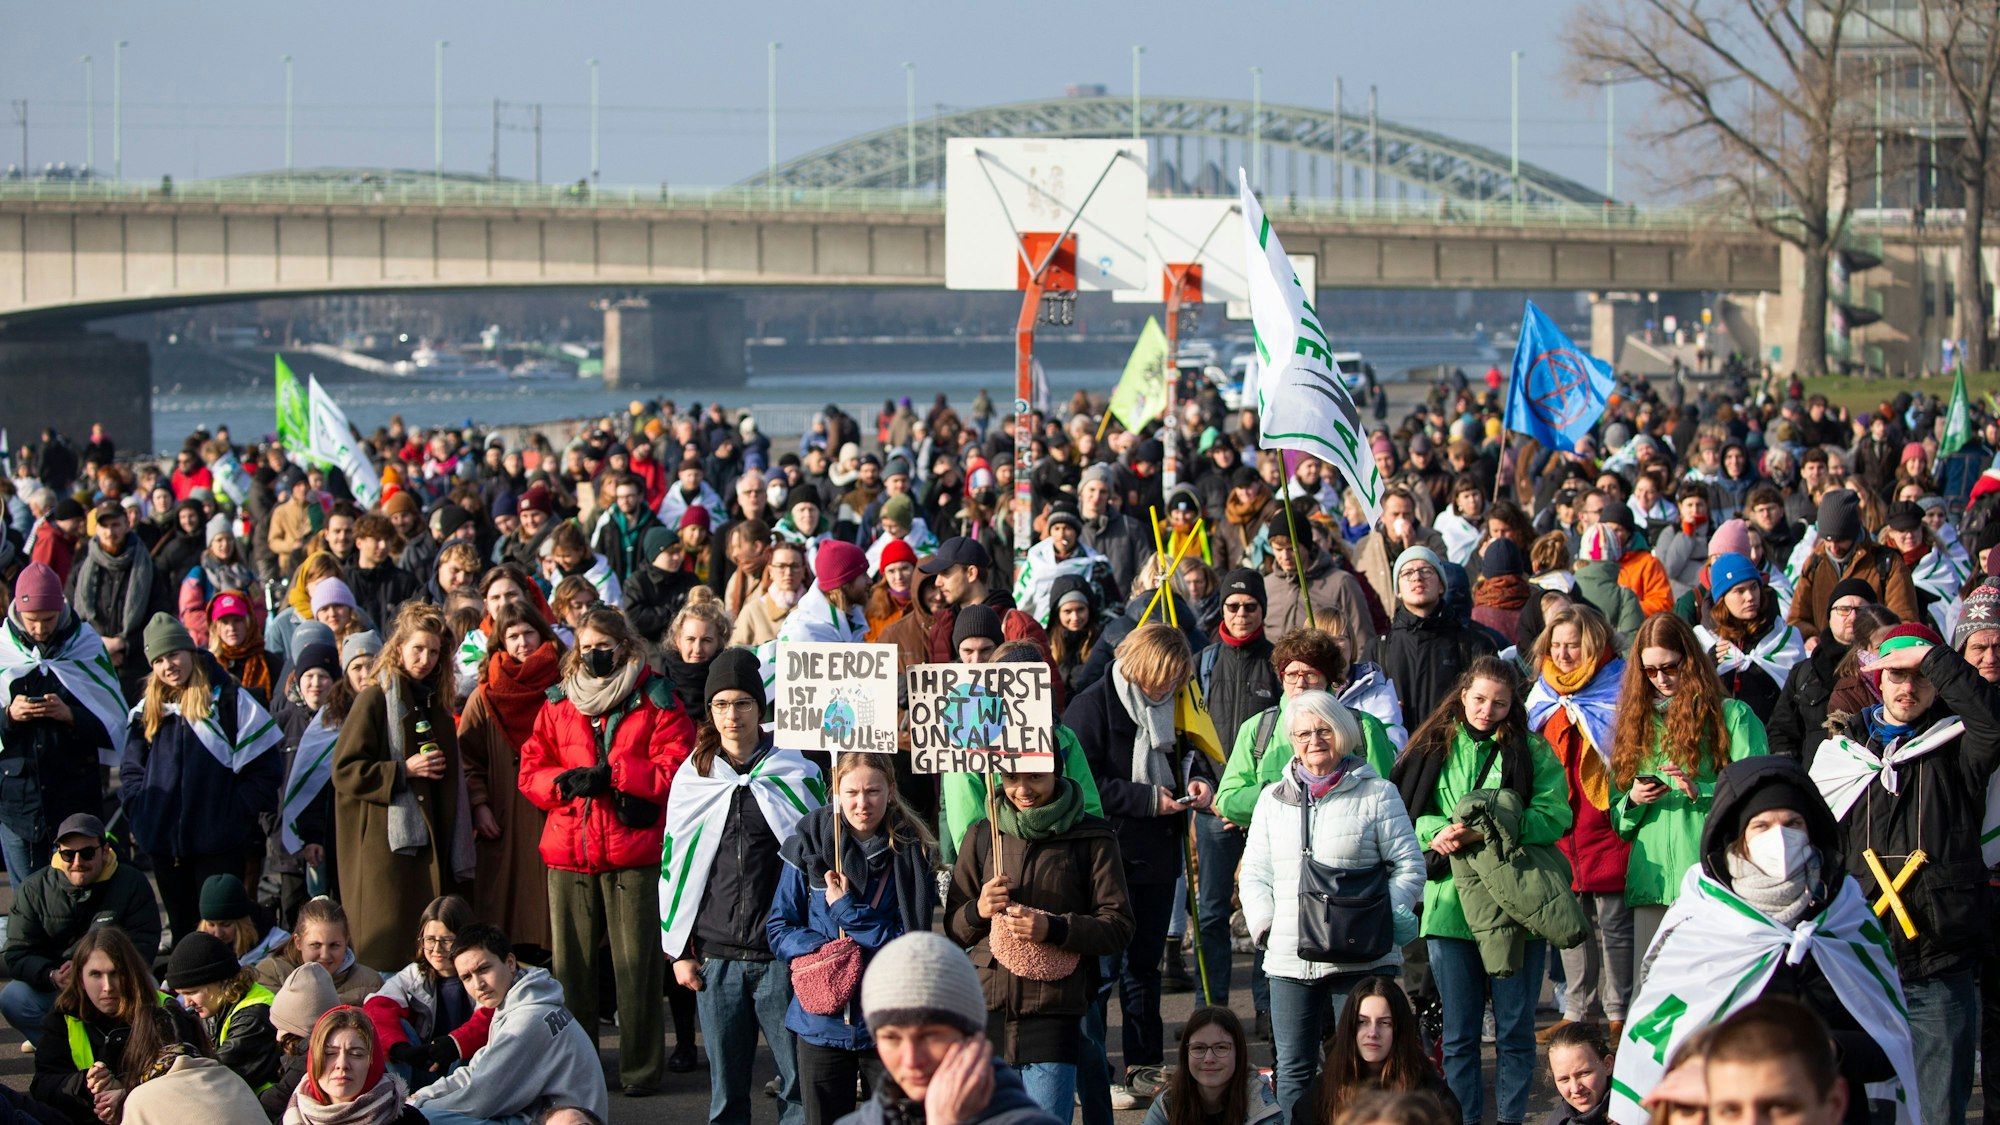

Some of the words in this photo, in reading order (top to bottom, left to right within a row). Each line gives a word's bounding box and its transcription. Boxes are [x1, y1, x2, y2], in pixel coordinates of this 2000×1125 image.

[786, 650, 824, 681] DIE
[828, 650, 890, 681] ERDE
[788, 686, 817, 706] IST
[910, 669, 961, 697] IHR
[777, 706, 823, 731] KEIN
[911, 695, 970, 726] ÖRT
[977, 698, 1028, 727] WAS
